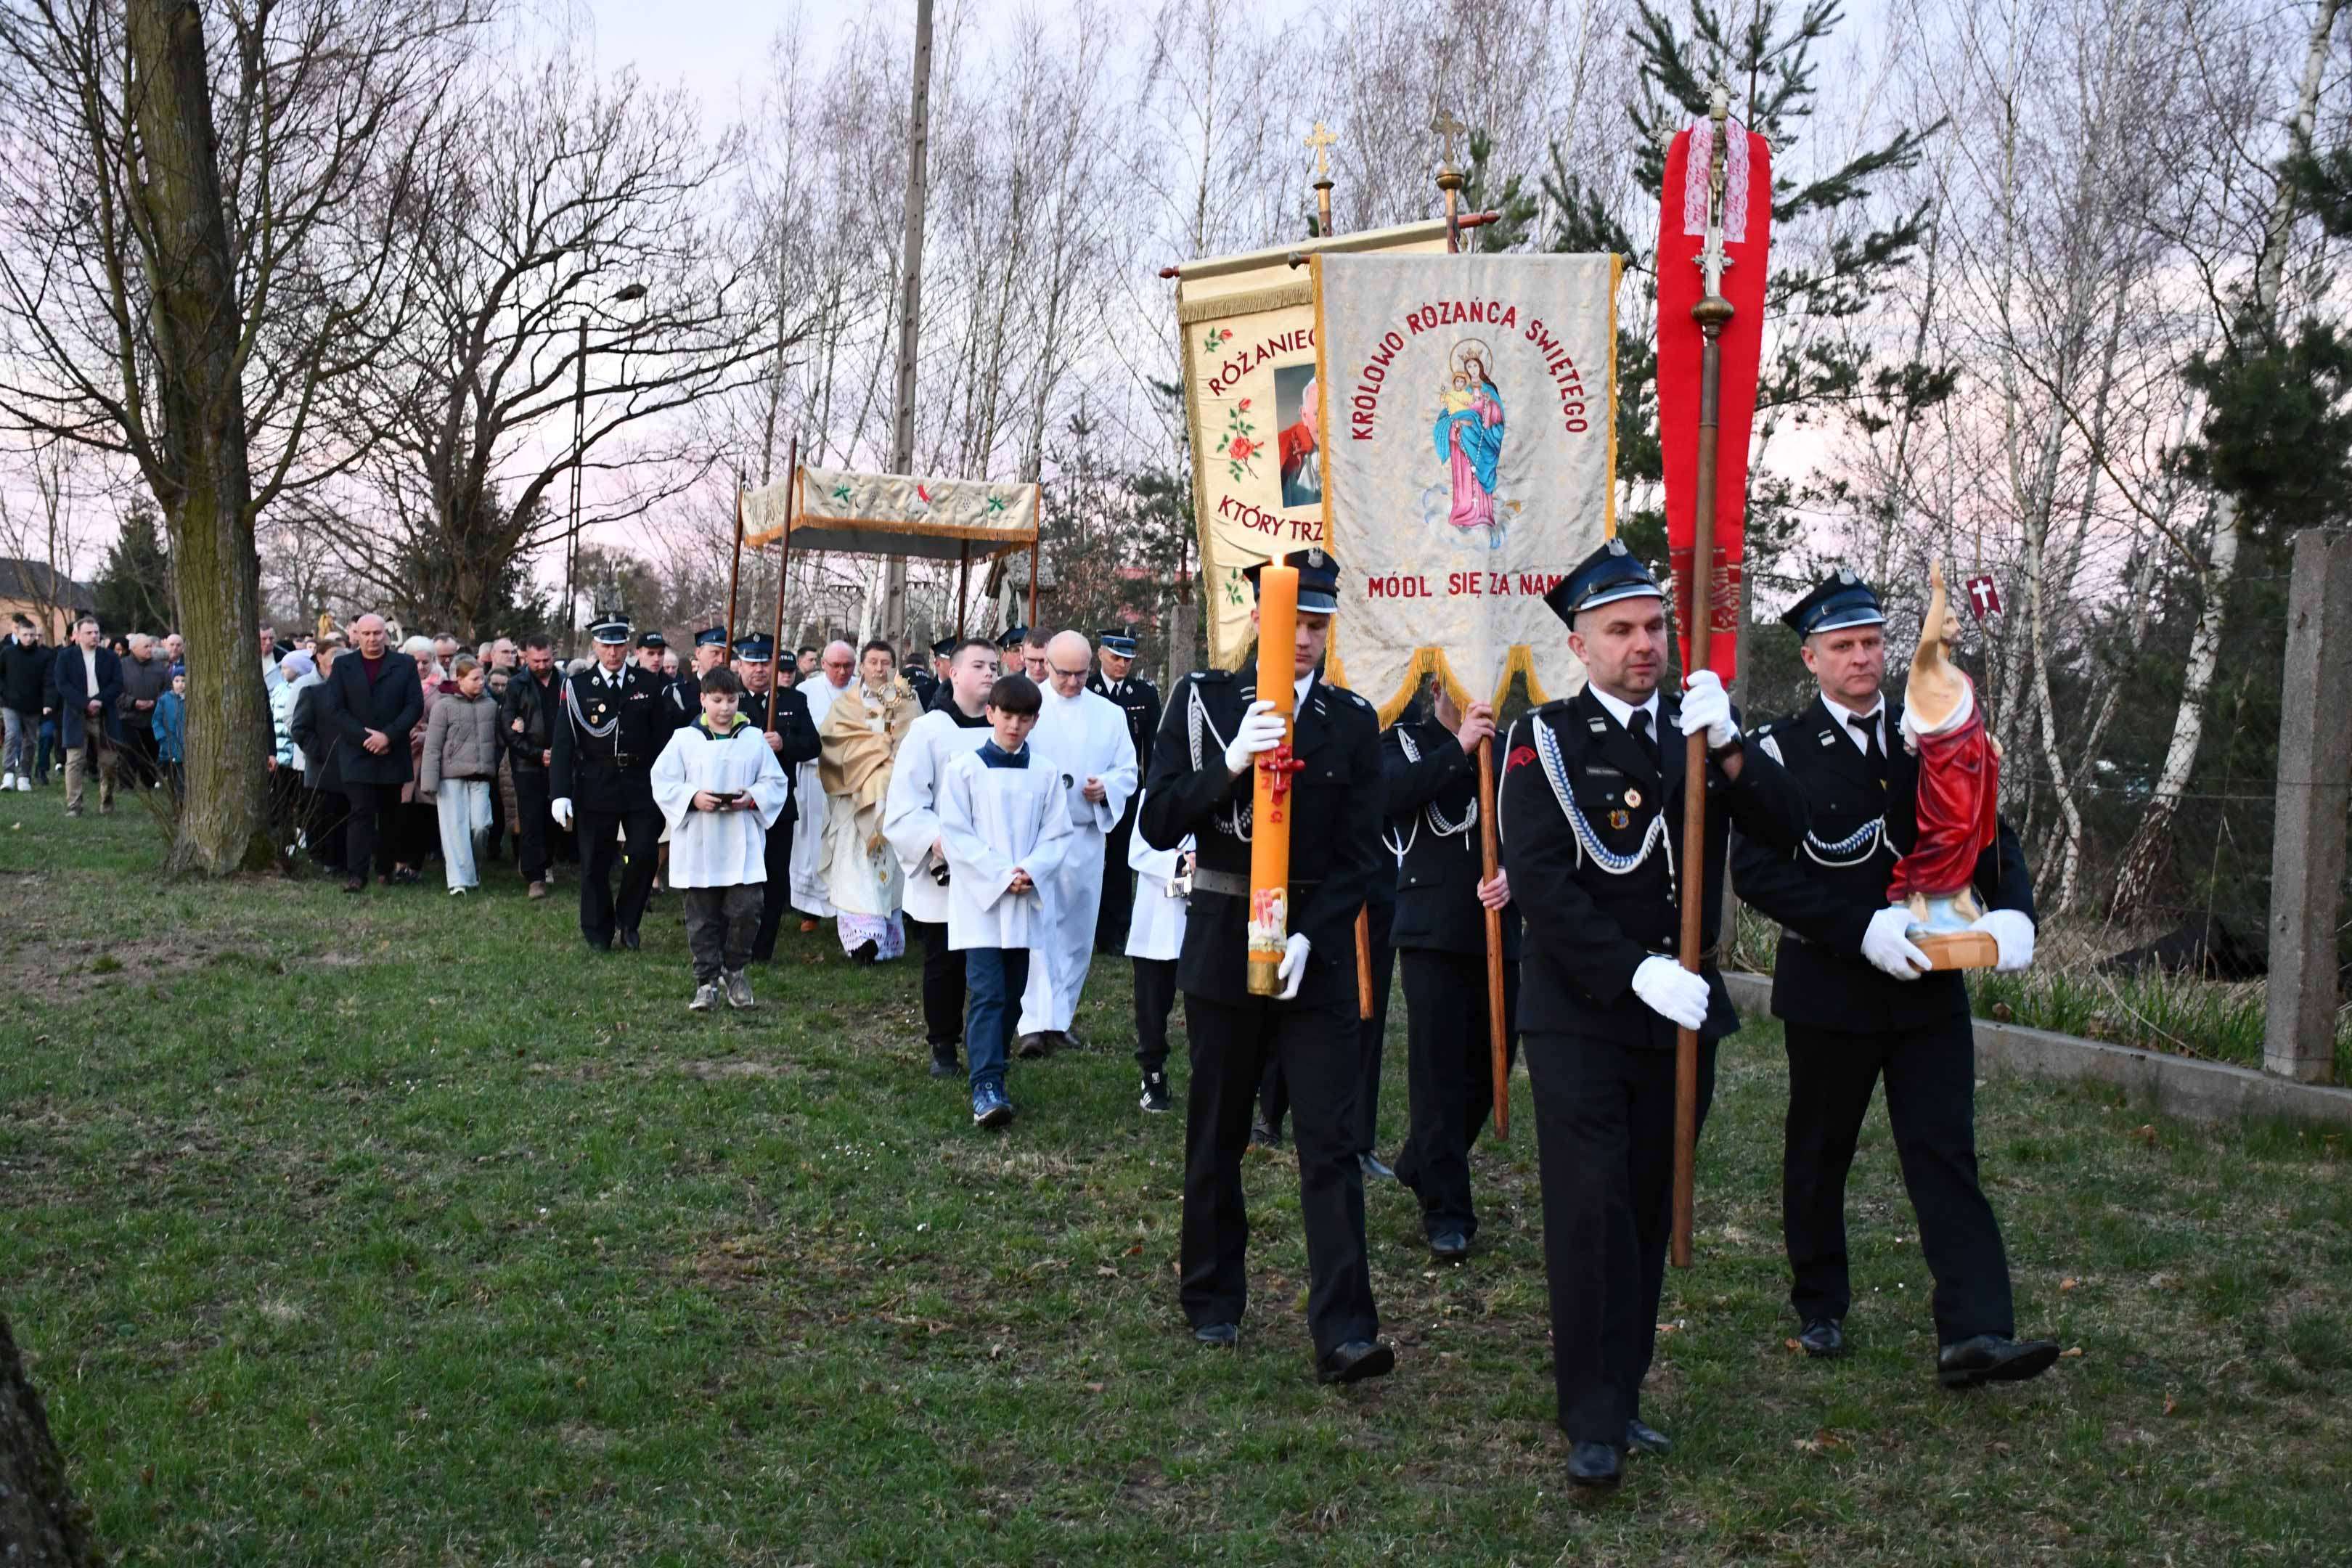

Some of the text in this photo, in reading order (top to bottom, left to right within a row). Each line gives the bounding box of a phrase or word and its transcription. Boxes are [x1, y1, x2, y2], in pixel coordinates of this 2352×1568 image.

[1351, 331, 1405, 441] KRÓLOWO
[1525, 317, 1588, 433] ŚWIĘTEGO
[1217, 494, 1286, 536] KTÓRY
[1368, 571, 1569, 599] MÓDL SIĘ ZA NAM
